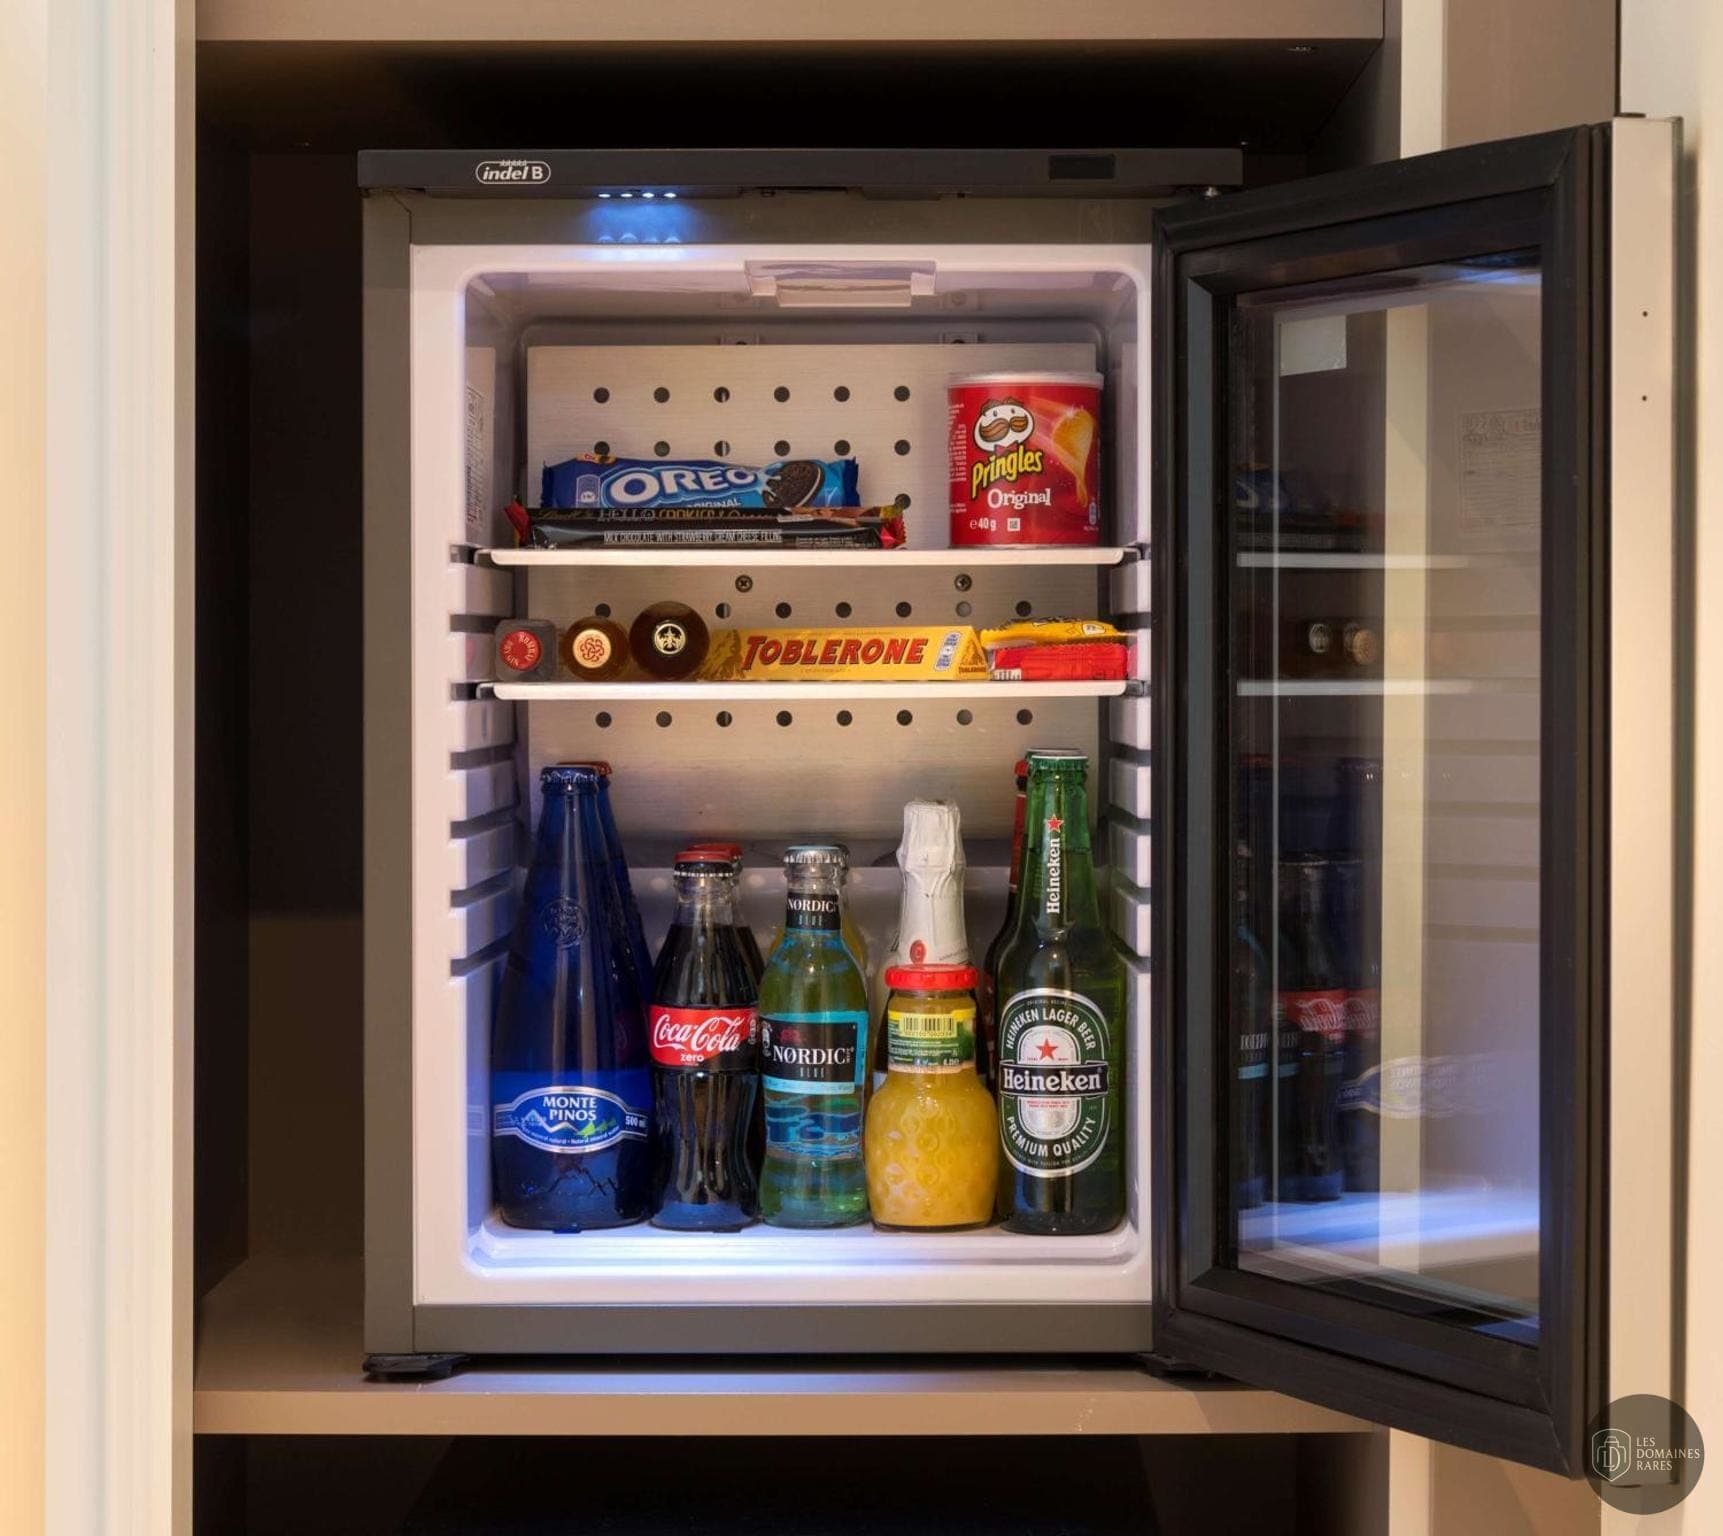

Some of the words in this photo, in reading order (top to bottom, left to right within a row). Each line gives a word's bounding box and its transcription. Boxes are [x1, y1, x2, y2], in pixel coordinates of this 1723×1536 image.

[483, 167, 528, 180] indel
[532, 166, 543, 180] B
[971, 445, 1043, 499] Pringles
[610, 467, 755, 503] OREO
[988, 488, 1052, 510] Original
[742, 636, 928, 670] TOBLERONE
[1046, 838, 1060, 914] Heineken
[1006, 1008, 1039, 1050] HEINEKEN
[1043, 1008, 1079, 1028] LAGER
[1077, 1021, 1097, 1050] BEER
[680, 1053, 704, 1062] zero
[1003, 1068, 1102, 1092] Heineken
[543, 1097, 598, 1109] MONTE
[550, 1109, 597, 1121] PINOS
[625, 1115, 638, 1126] 500
[1007, 1116, 1049, 1157] PREMIUM
[1053, 1116, 1097, 1157] QUALITY
